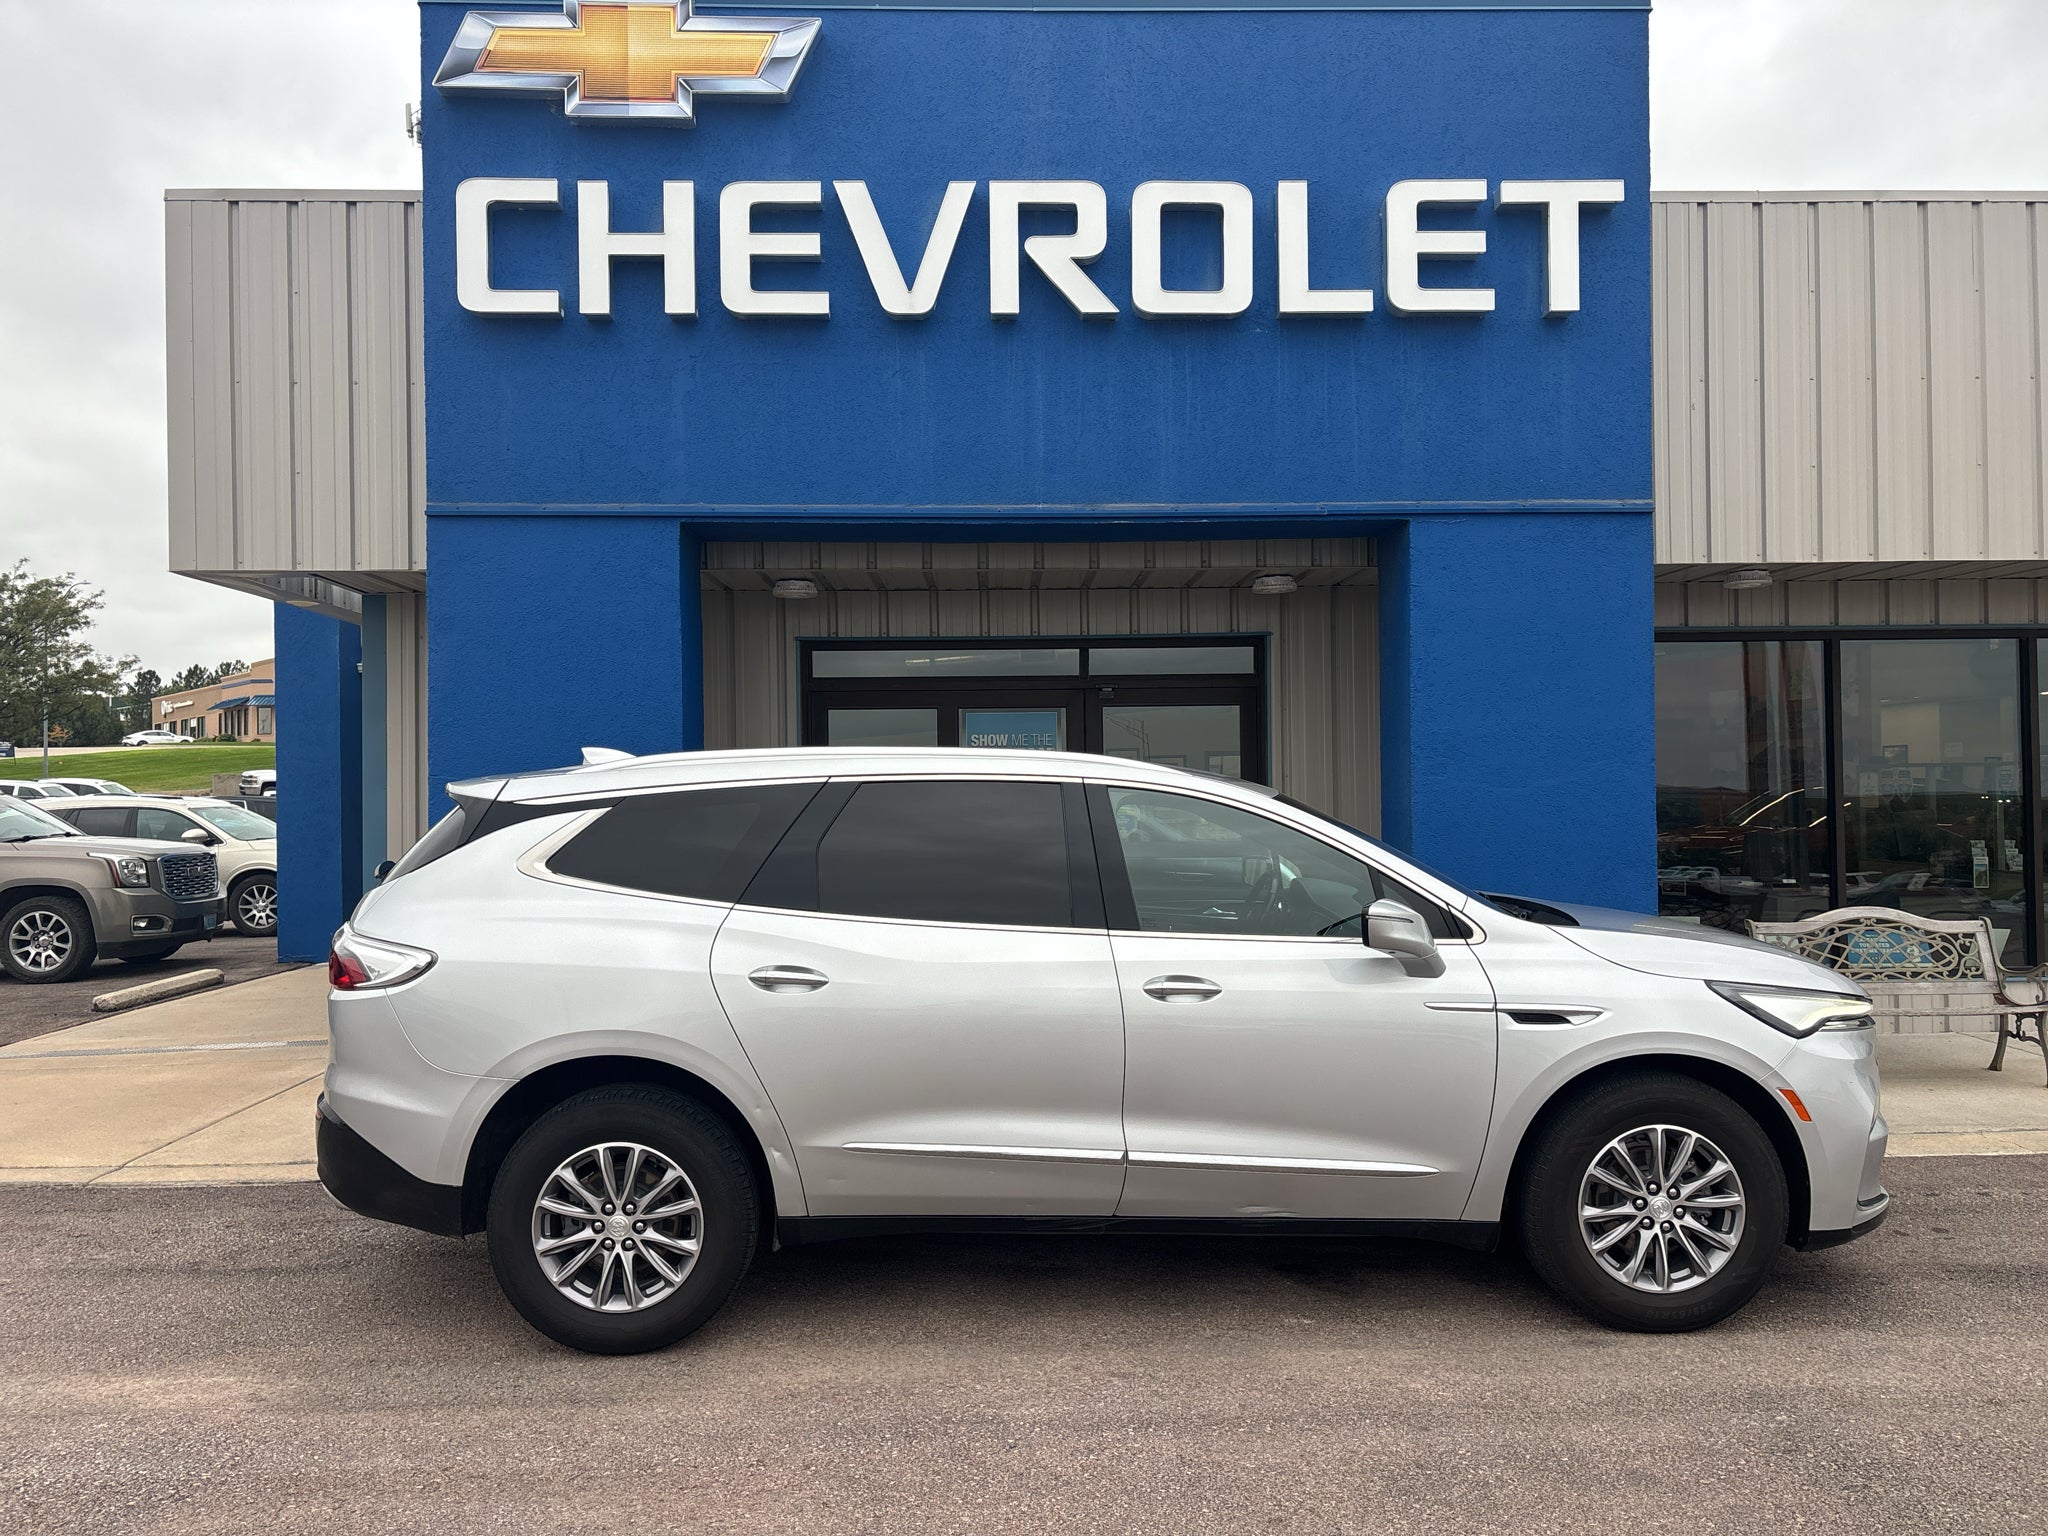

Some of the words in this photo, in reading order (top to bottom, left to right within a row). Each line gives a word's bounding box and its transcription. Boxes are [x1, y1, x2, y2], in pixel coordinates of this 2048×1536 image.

[455, 177, 1625, 318] CHEVROLET
[971, 734, 1008, 747] SHOW
[1011, 734, 1028, 746] ME
[1031, 733, 1053, 746] THE
